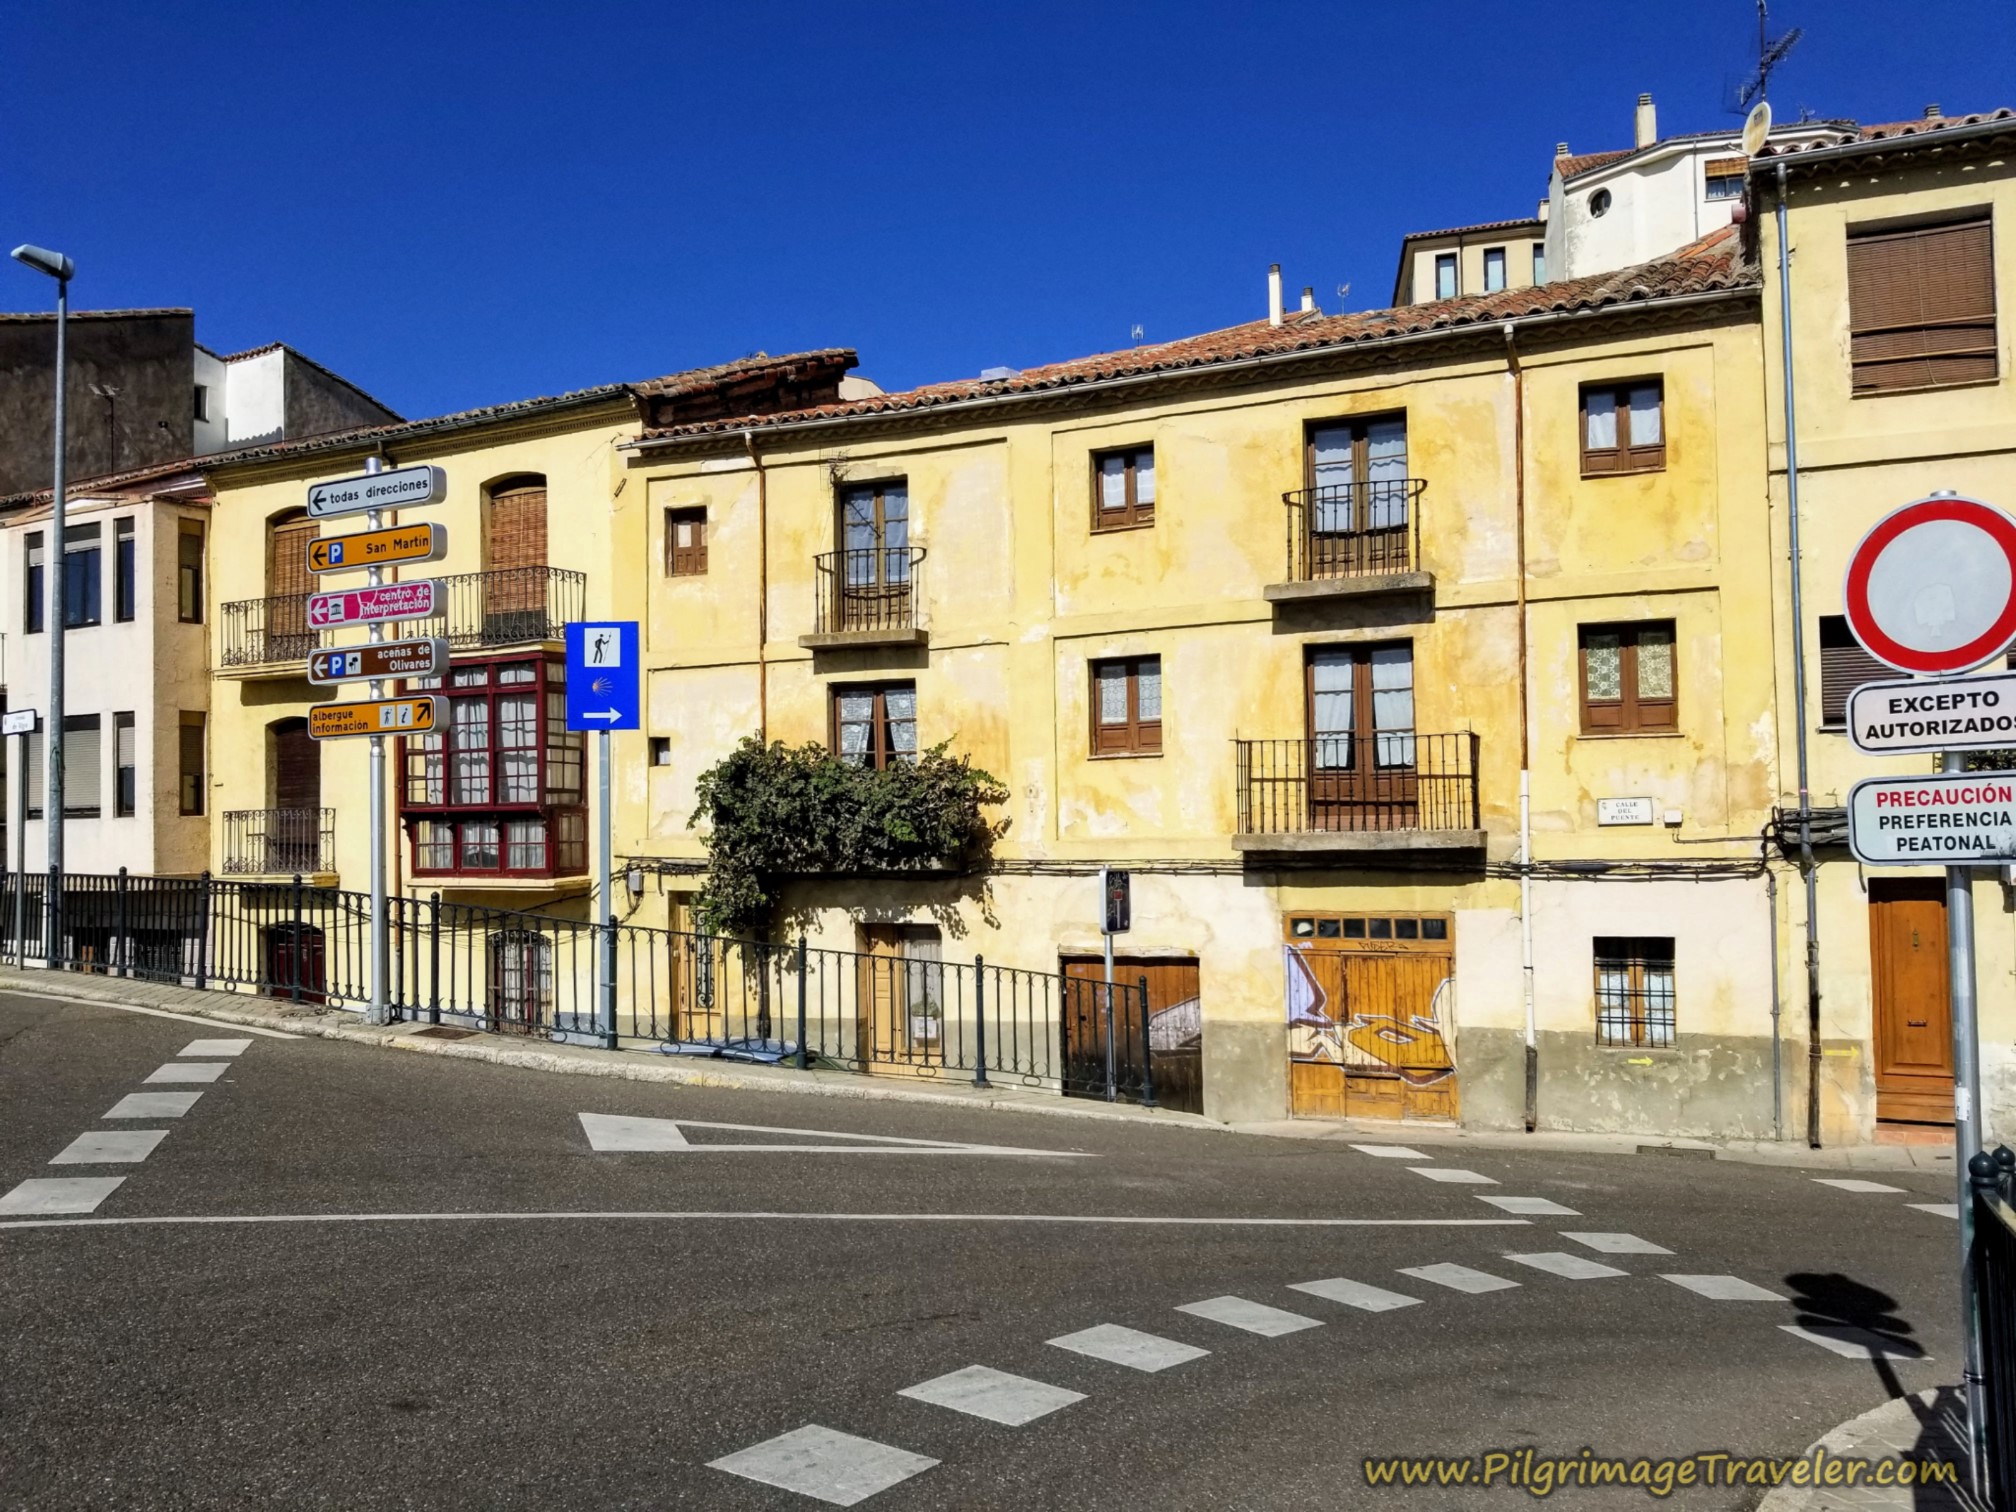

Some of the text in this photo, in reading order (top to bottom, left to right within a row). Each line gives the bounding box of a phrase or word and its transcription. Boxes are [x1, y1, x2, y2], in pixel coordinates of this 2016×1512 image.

[330, 479, 428, 504] todas direcciones
[331, 544, 341, 563] P
[366, 543, 386, 554] San
[380, 585, 430, 602] centro de
[361, 596, 430, 616] interpretación
[332, 645, 430, 675] P aceñas de
[389, 659, 431, 671] Olivares
[1889, 691, 2000, 715] EXCEPTO
[312, 709, 354, 722] albergue
[312, 720, 369, 734] información
[1865, 716, 2016, 740] AUTORIZADO
[1876, 783, 2013, 808] PRECAUCIÓN
[1879, 811, 2013, 830] PREFERENCIA
[1897, 835, 1996, 852] PEATONAL
